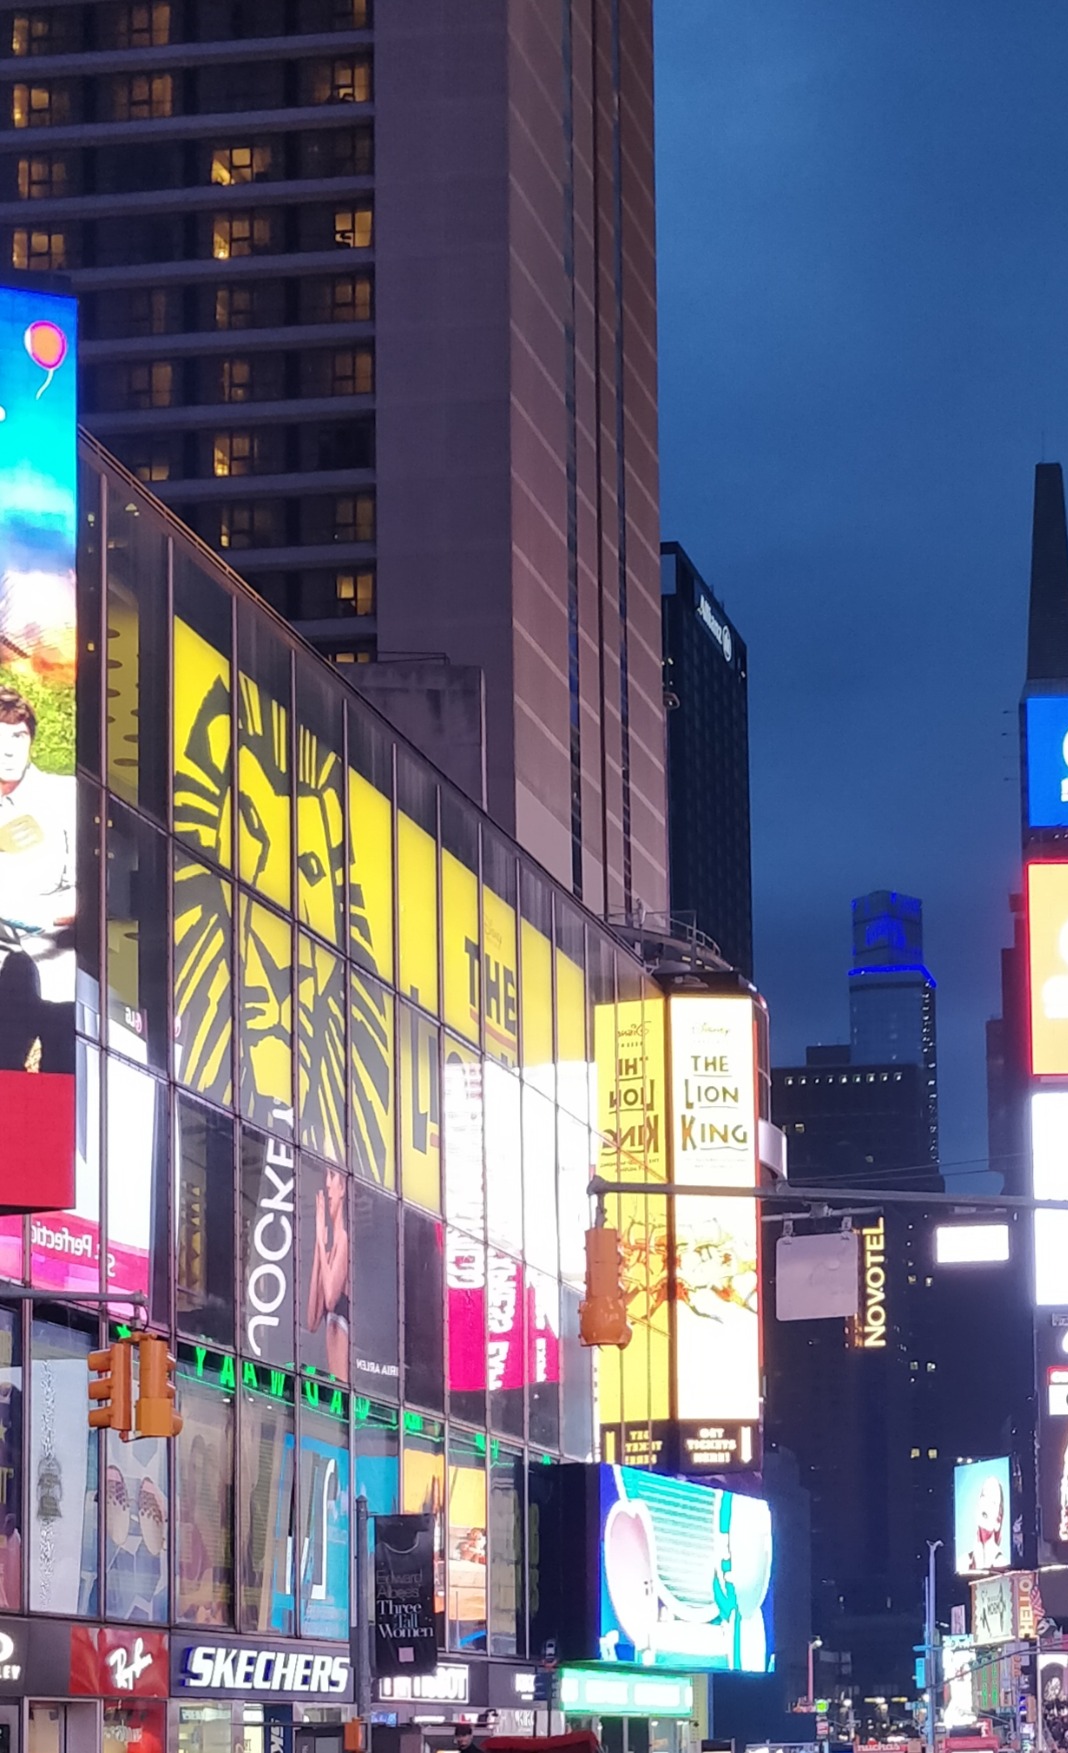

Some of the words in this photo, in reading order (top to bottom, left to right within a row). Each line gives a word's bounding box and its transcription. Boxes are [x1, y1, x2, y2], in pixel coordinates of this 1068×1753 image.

[464, 935, 517, 1036] THE
[690, 1055, 729, 1072] THE
[684, 1078, 739, 1109] LION
[681, 1114, 748, 1151] KING
[862, 1216, 887, 1347] NOVOTEL
[376, 1600, 422, 1615] Three
[378, 1623, 434, 1639] Women
[394, 1613, 418, 1629] Tall
[0, 1665, 21, 1680] EY
[184, 1646, 351, 1693] SKECHERS
